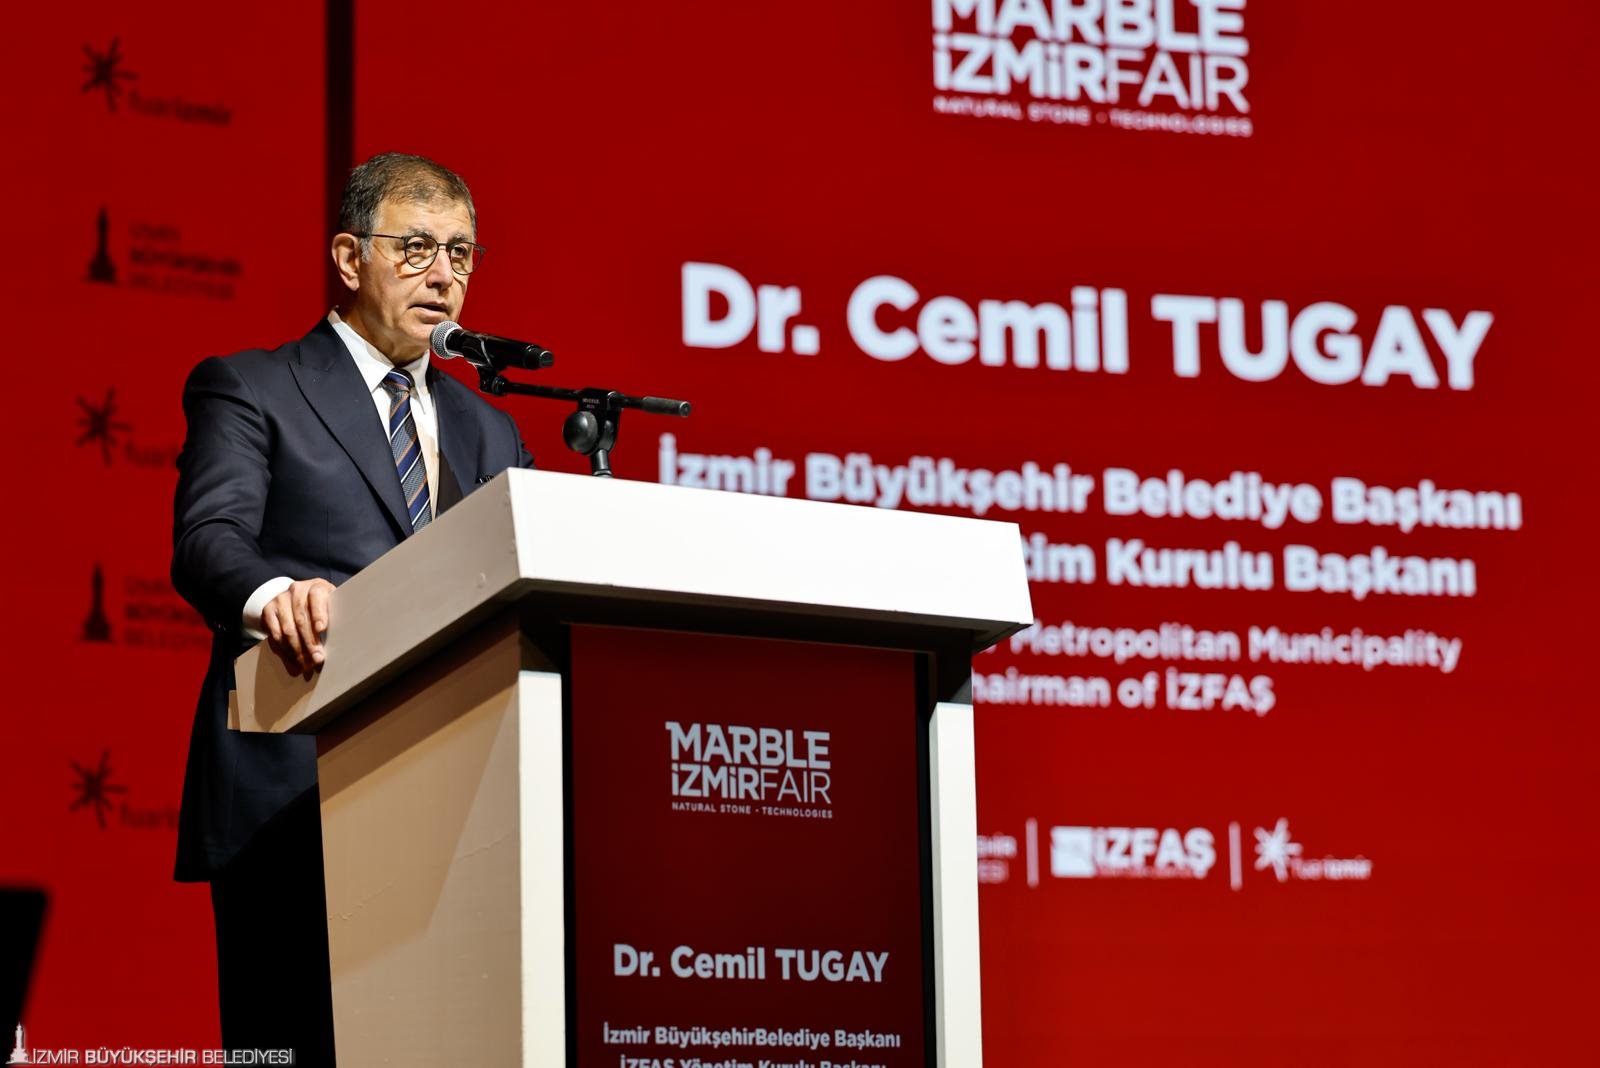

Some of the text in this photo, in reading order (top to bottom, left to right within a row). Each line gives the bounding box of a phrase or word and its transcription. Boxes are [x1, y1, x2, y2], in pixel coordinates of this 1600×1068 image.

[932, 0, 1249, 56] MARBLE
[933, 97, 1253, 137] NATURAL STONE TECHNOLOGIES
[681, 261, 1494, 390] Dr. Cemil TUGAY
[659, 433, 1522, 534] İzmir Büyükşehir Belediye Başkanı
[1106, 537, 1275, 590] Kurulu
[1283, 544, 1477, 601] Başkanı
[1010, 618, 1462, 673] Metropolitan Municipality
[972, 666, 1276, 717] hairman of İZFAŞ
[665, 721, 831, 769] MARBLE
[672, 802, 833, 819] NATURAL STONE TECHNOLOGIES
[1095, 827, 1216, 879] İZFAŞ
[613, 944, 889, 982] Dr. Cemil TUGAY
[603, 1021, 650, 1044] İzmir
[834, 1029, 901, 1050] Başkanı
